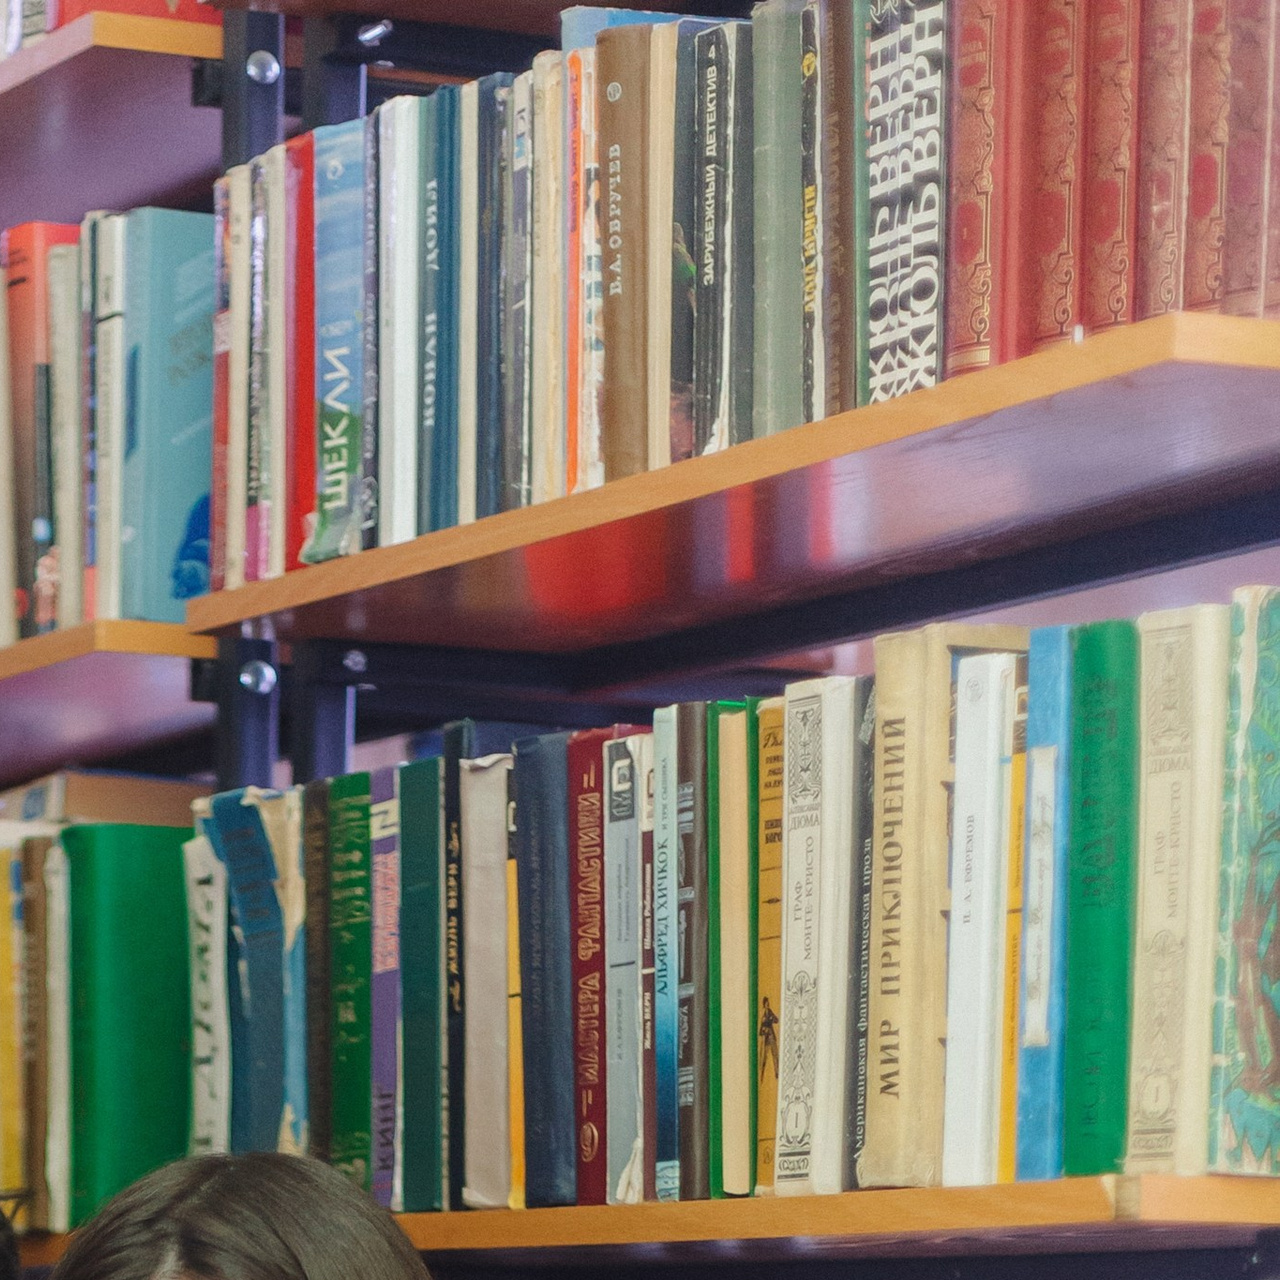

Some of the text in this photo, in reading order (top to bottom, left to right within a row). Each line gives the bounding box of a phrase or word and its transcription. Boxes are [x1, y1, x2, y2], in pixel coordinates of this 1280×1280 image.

[705, 64, 719, 157] ДЕТЕКТИВ
[607, 144, 622, 249] ОБРУЧЕВ
[703, 164, 717, 286] ЗАРУБЕЖНЫЙ
[910, 1, 944, 388] ЖЮЛЬ ВЕРН
[423, 179, 440, 426] КОНАН ДОЙЛ
[323, 346, 351, 511] ШЕКЛИ
[656, 837, 670, 912] ХИЧКОК
[788, 813, 820, 832] ДЮМА
[578, 792, 601, 1086] МАСТЕРА ФАНТАСТИКИ
[655, 914, 670, 997] АЛЬФРЕД
[793, 881, 804, 922] ГРАФ
[878, 715, 907, 1100] МИР ПРИКЛЮЧЕНИЙ
